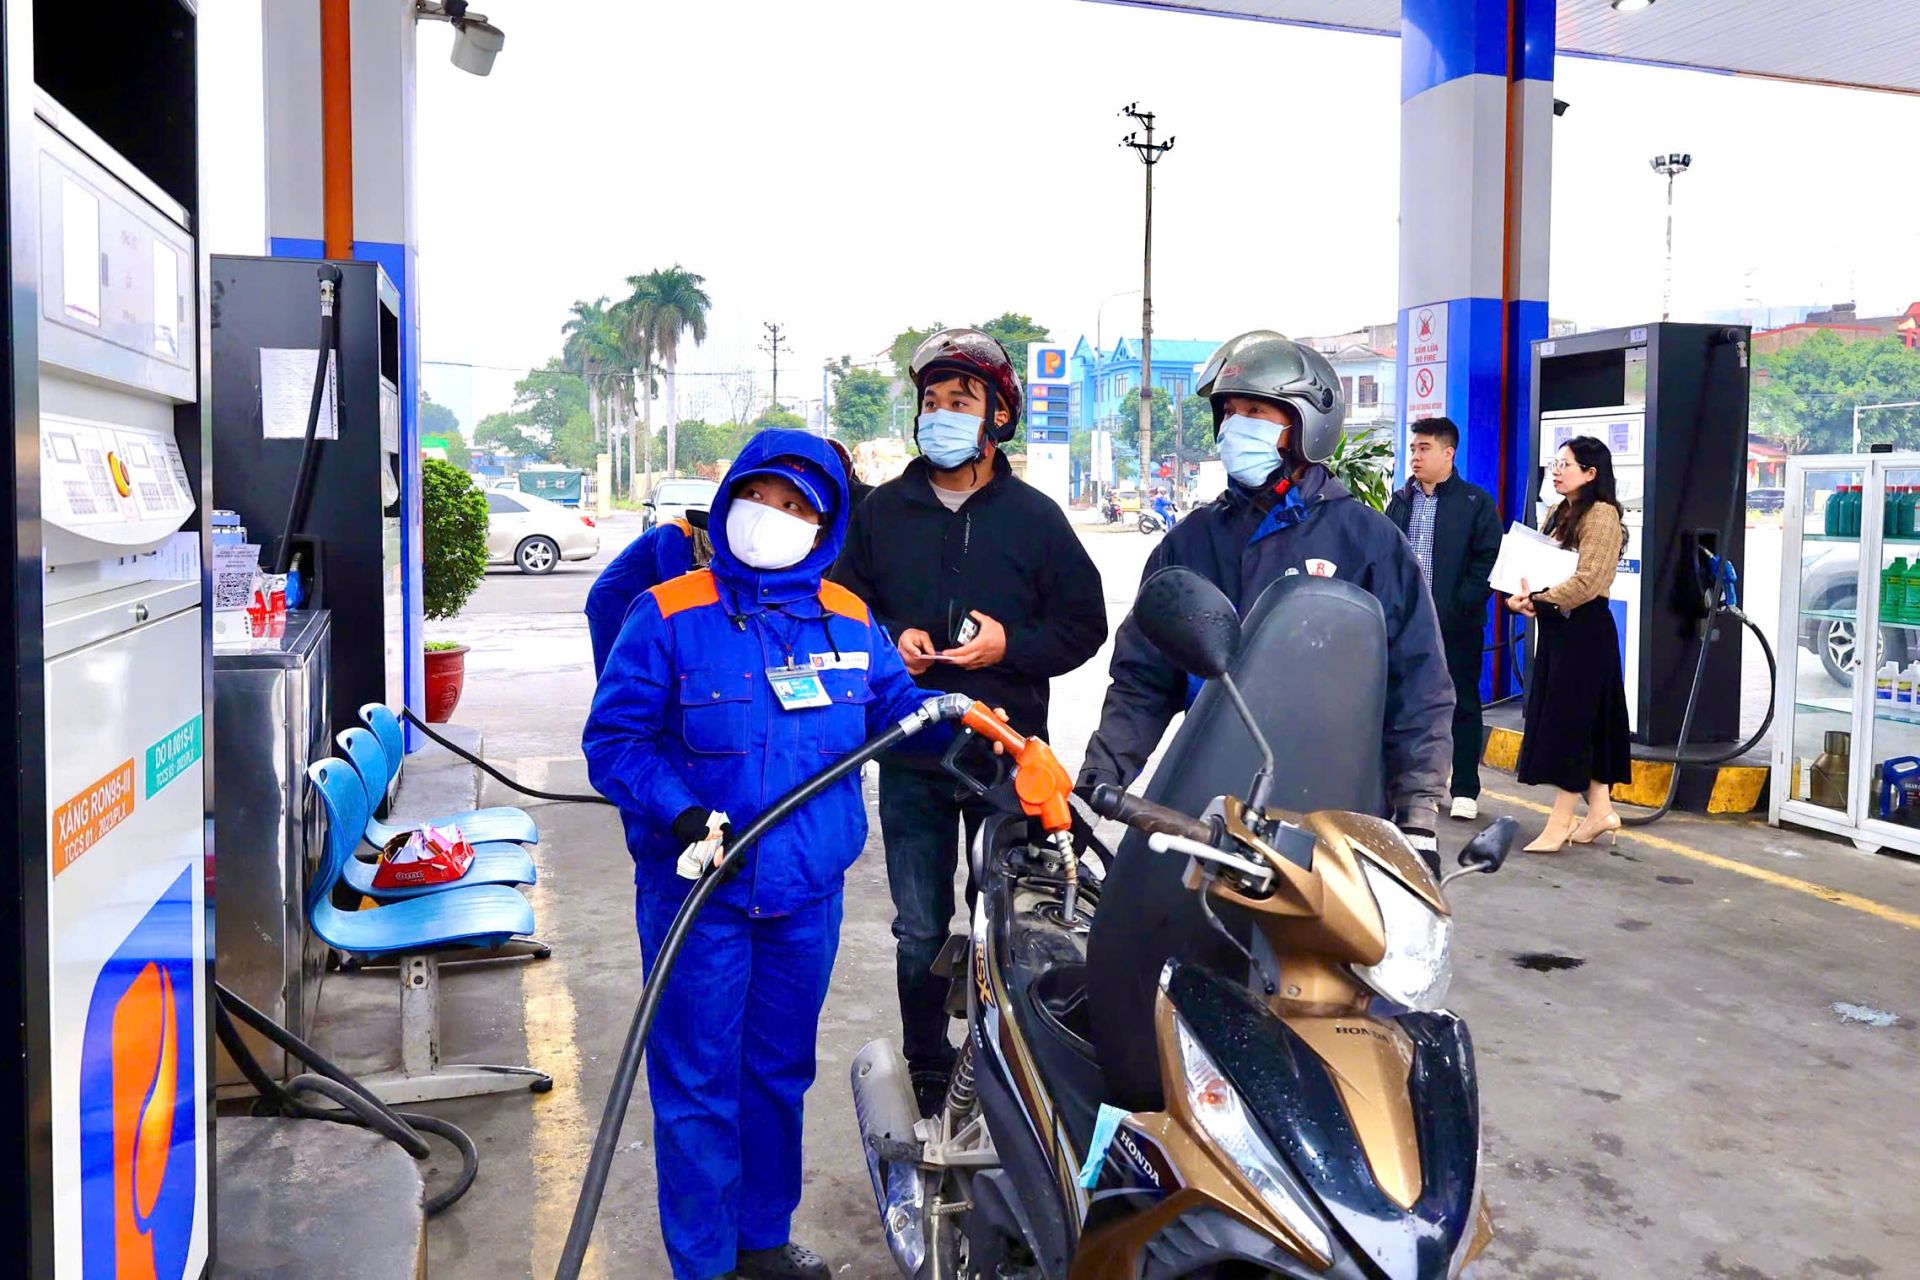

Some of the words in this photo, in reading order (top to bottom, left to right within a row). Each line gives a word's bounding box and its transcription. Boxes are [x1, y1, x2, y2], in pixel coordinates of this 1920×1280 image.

[1424, 353, 1437, 362] FIRE
[155, 743, 167, 770] DO
[168, 721, 194, 762] 0,001S-V
[156, 767, 169, 789] TCCS
[59, 798, 89, 844] XĂNG
[91, 767, 131, 819] RON95-III
[64, 833, 84, 865] TCCS
[85, 826, 93, 848] 01
[99, 801, 127, 837] 2023/PLX
[1335, 1027, 1391, 1044] HONDA
[1120, 1130, 1160, 1188] HONDA
